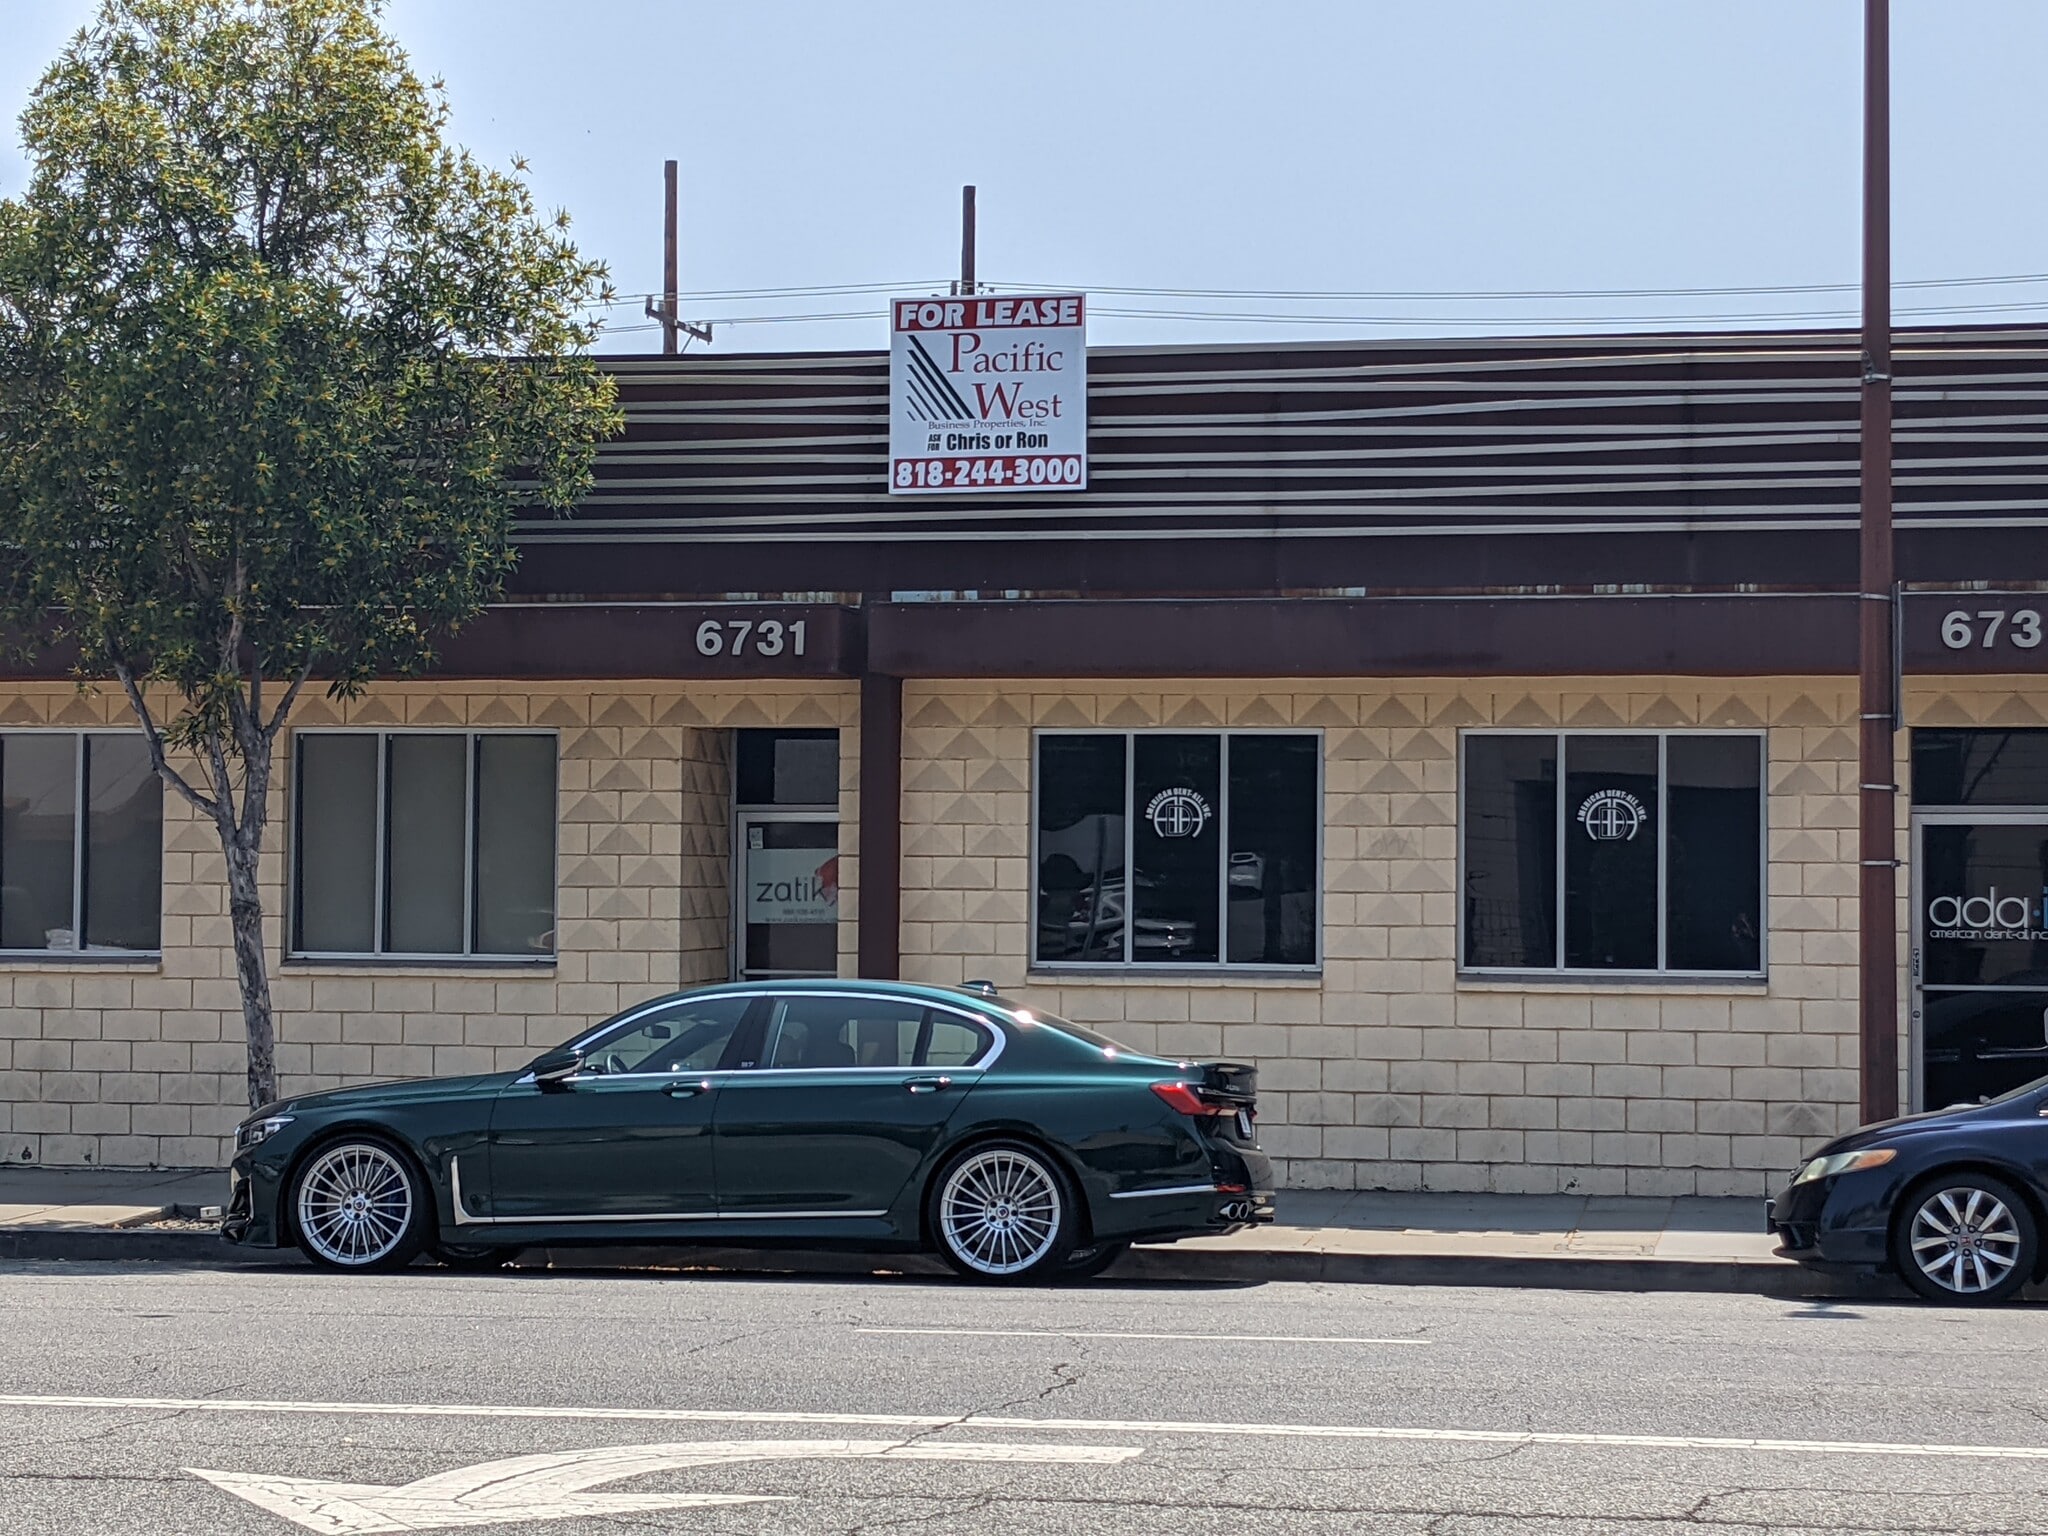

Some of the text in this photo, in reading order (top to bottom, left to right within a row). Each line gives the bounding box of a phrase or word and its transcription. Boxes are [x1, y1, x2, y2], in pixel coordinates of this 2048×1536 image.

[900, 299, 1079, 329] FOR LEASE
[947, 332, 1063, 374] Pacific
[971, 381, 1062, 420] West
[928, 420, 970, 430] Business
[928, 433, 942, 442] ASK
[927, 443, 940, 452] FOR
[946, 431, 1048, 451] Chris or Ron
[896, 457, 1080, 487] 818-244-3000
[696, 619, 805, 656] 6731
[1145, 788, 1173, 820] AMERICAN
[1576, 789, 1606, 822] AMERICAN
[756, 876, 828, 902] zatik
[1930, 927, 1982, 940] american
